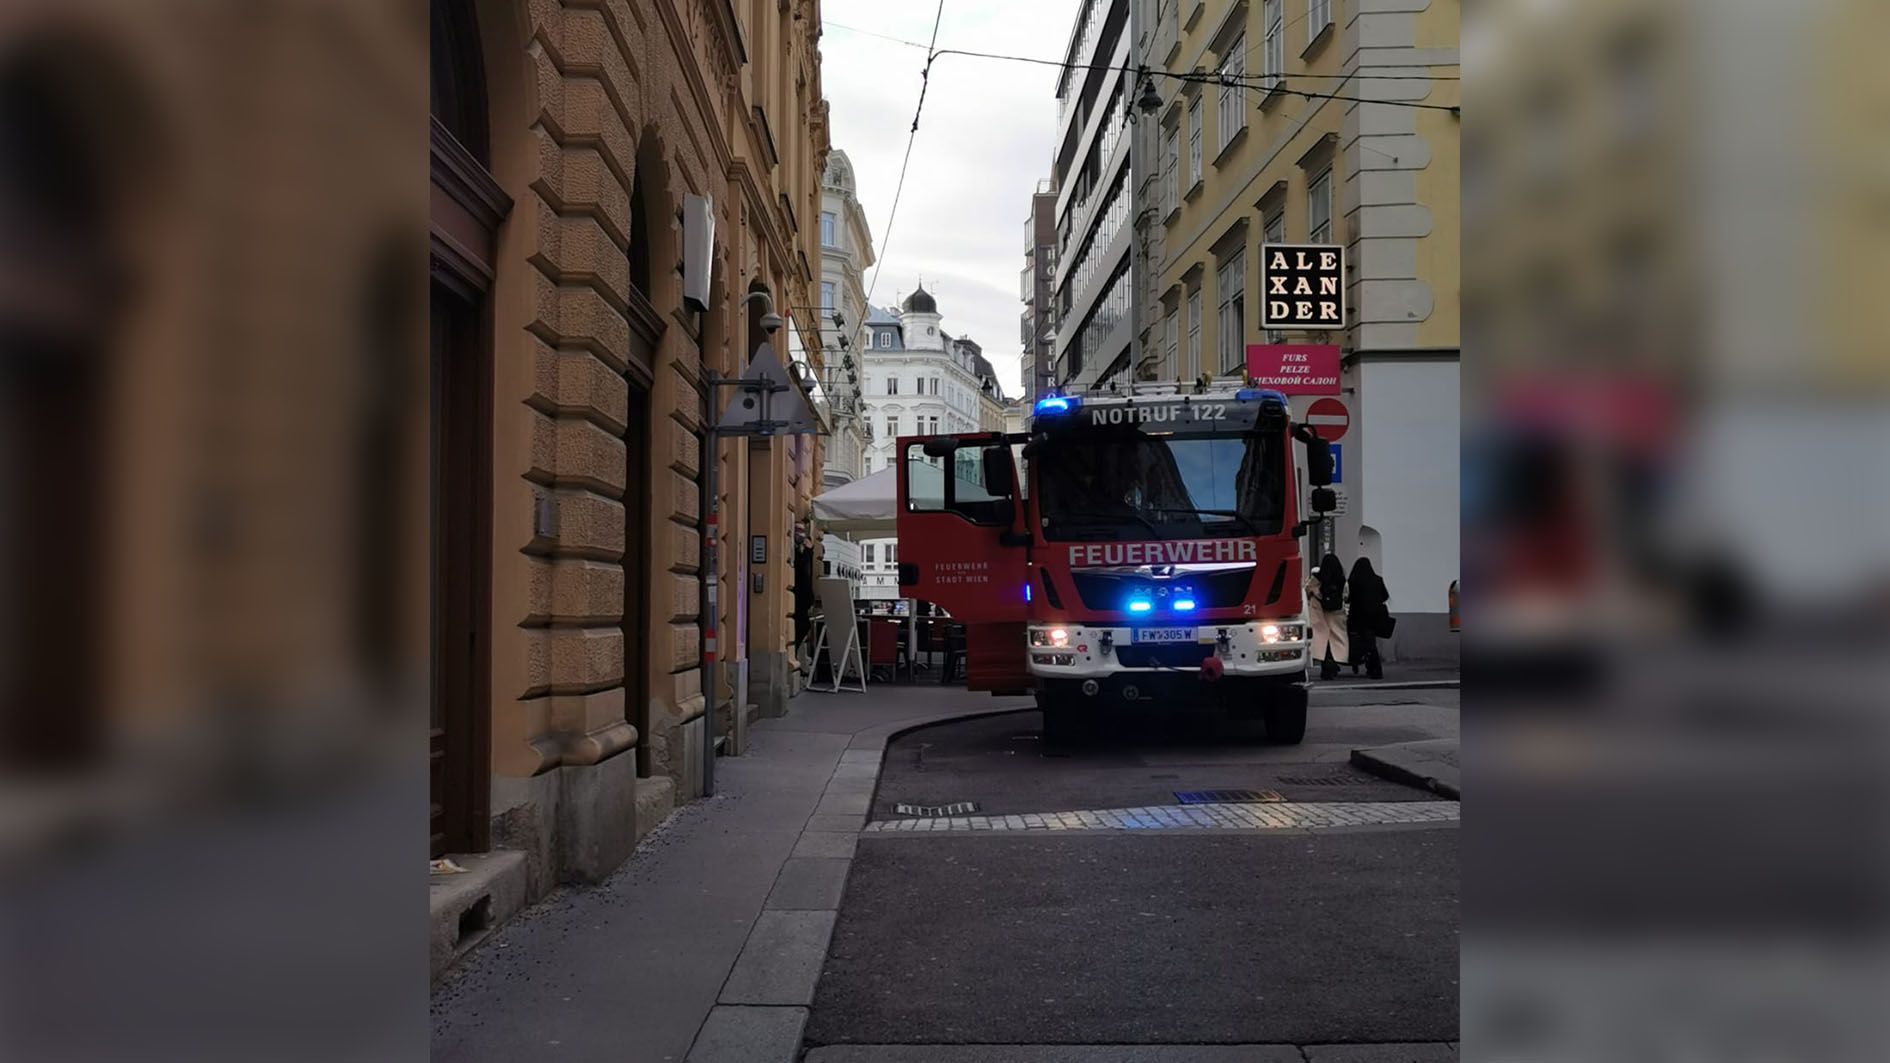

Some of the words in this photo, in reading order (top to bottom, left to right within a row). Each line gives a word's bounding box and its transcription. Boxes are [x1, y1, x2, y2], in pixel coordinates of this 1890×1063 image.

[1269, 252, 1337, 270] ALE
[1269, 276, 1338, 295] XAN
[1270, 301, 1339, 320] DER
[1280, 365, 1311, 373] PELZE
[1303, 377, 1337, 385] САЛОН
[1092, 405, 1181, 425] NOTRUF
[1191, 404, 1226, 420] 122
[1069, 540, 1257, 566] FEUERWEHR
[935, 562, 988, 570] FEUERWEHR
[936, 575, 962, 584] STADT
[966, 575, 989, 584] WIEN
[1244, 604, 1256, 615] 21
